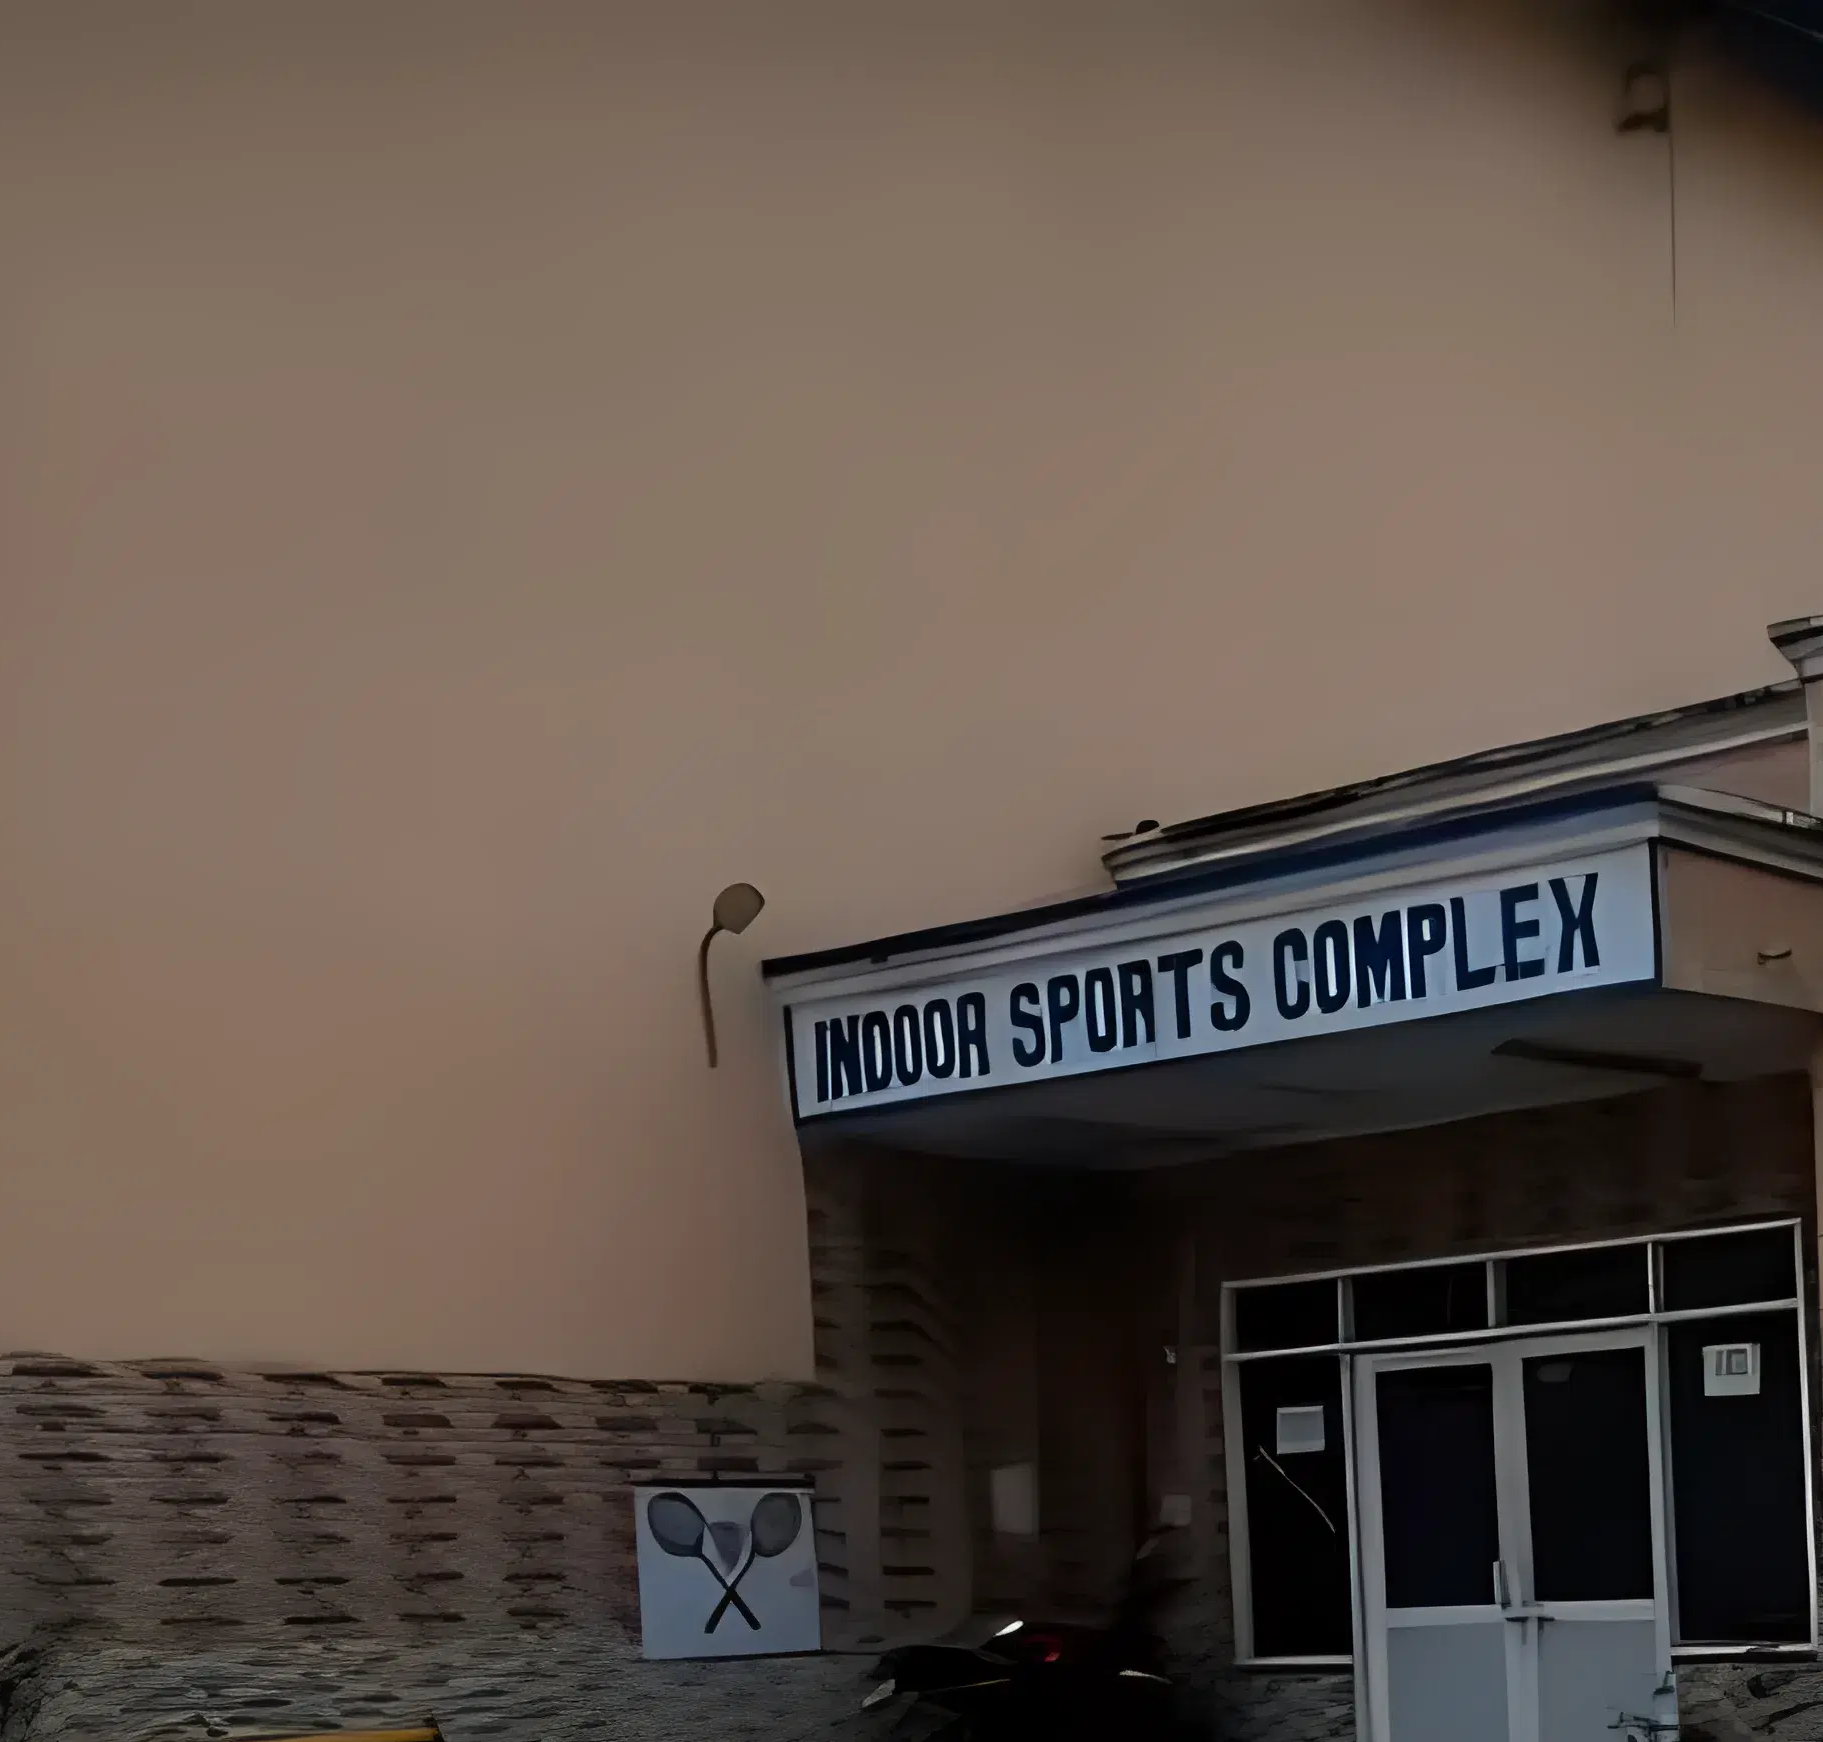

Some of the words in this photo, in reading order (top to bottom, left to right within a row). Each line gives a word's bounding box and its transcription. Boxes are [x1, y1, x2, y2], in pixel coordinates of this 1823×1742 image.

[814, 991, 991, 1103] INDOOR
[1010, 940, 1251, 1068] SPORTS
[1273, 872, 1600, 1020] COMPLEX
